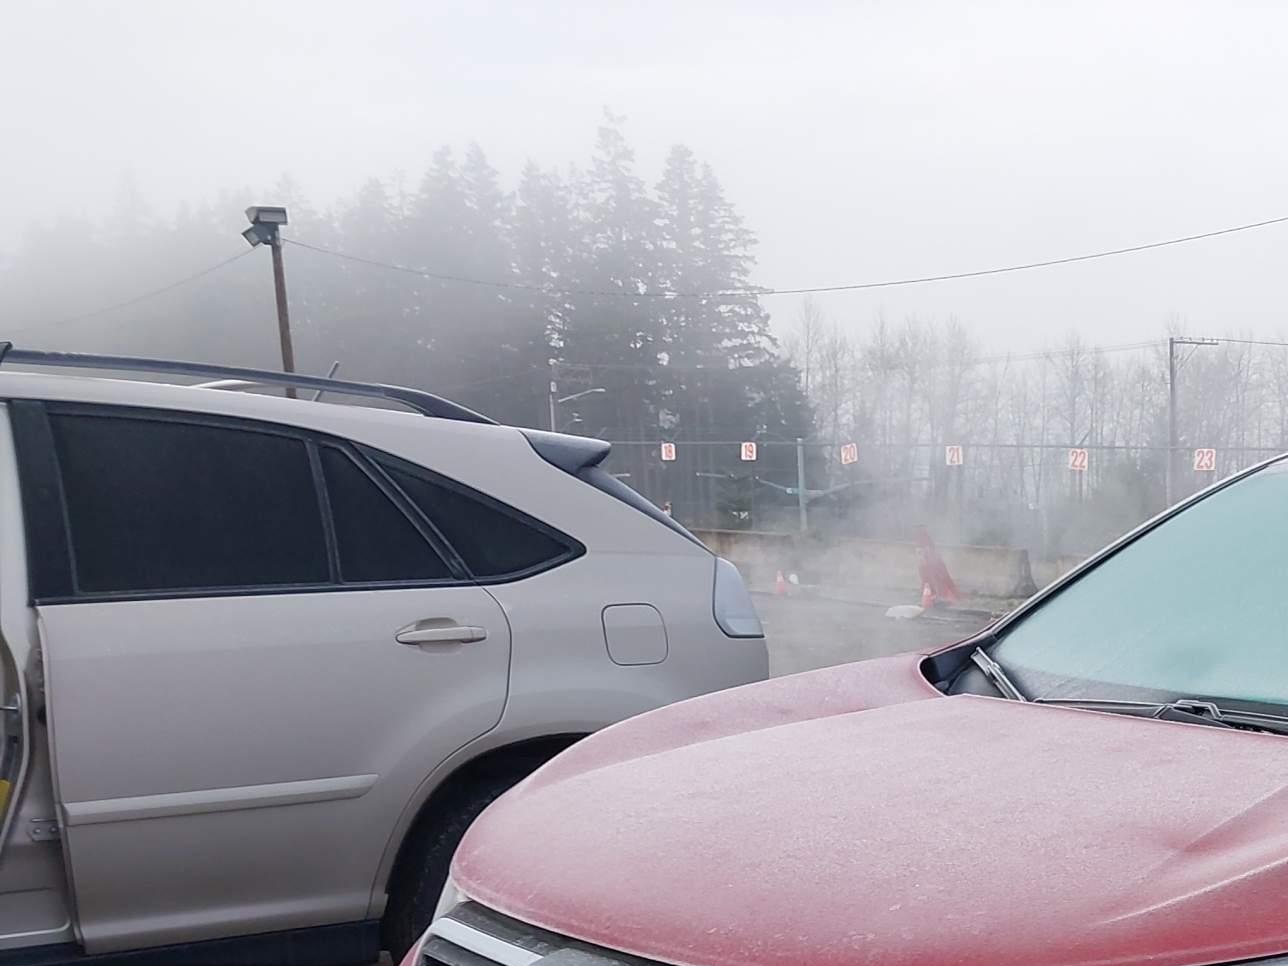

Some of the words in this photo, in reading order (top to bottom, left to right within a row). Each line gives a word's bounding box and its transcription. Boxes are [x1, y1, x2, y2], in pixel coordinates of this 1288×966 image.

[843, 444, 857, 462] 20
[948, 447, 961, 464] 21
[1071, 450, 1087, 469] 22
[1196, 450, 1214, 469] 23
